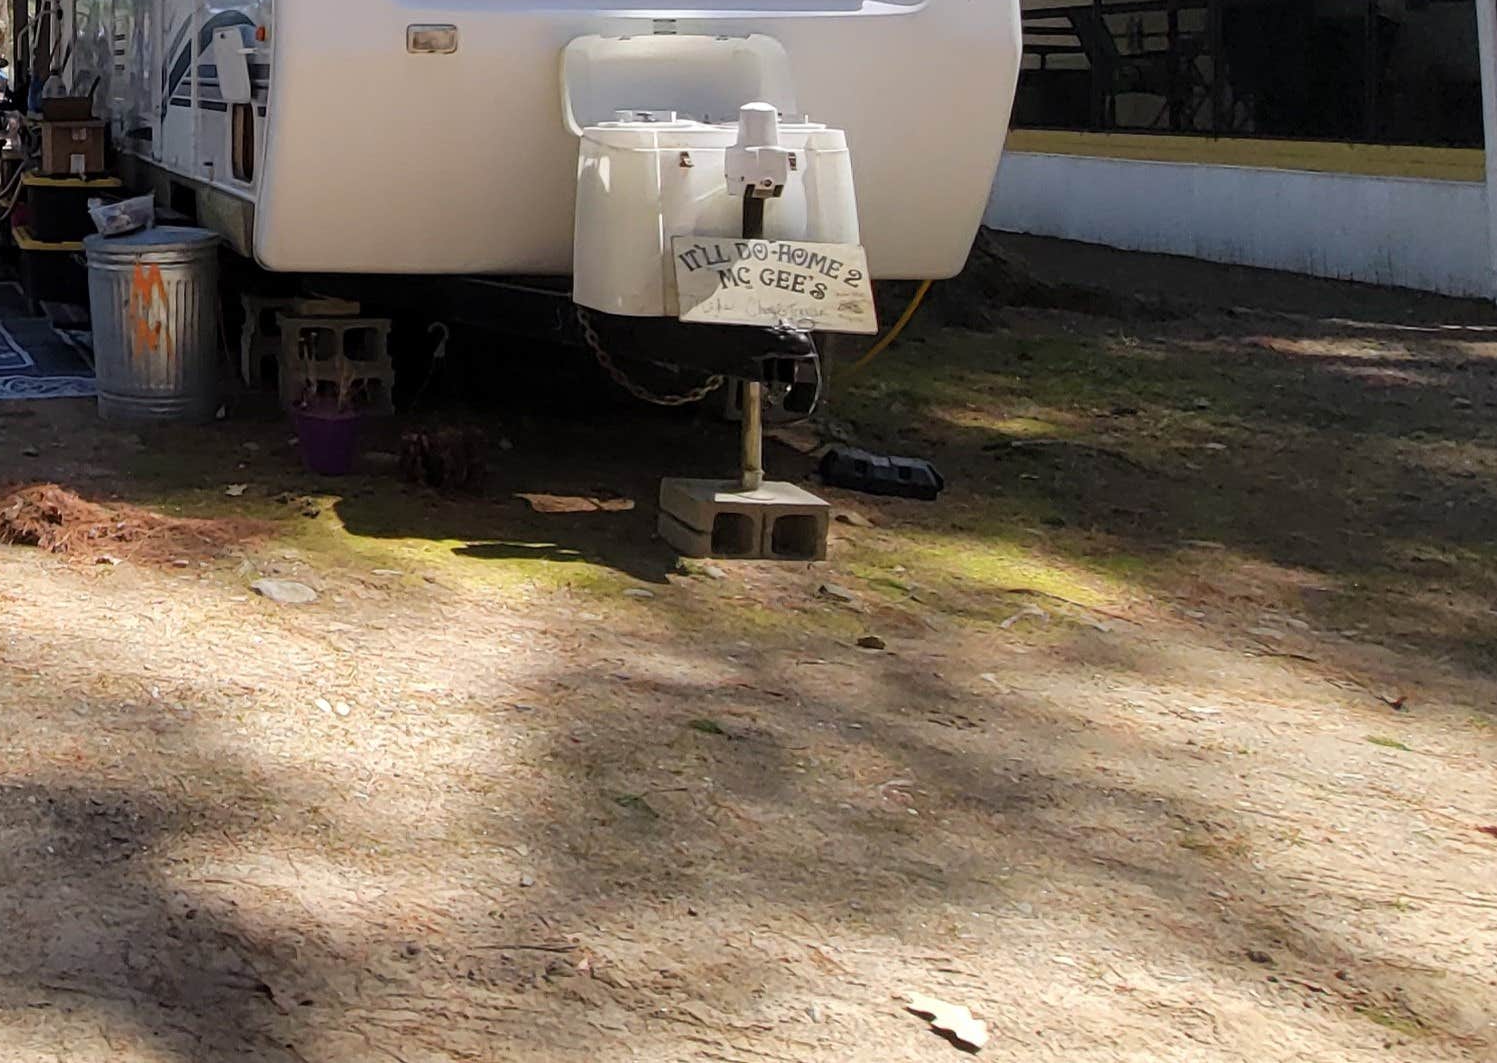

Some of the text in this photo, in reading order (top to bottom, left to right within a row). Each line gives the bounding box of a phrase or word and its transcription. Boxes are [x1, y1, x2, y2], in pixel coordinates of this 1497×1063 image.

[678, 243, 731, 273] IT'LL
[843, 268, 863, 288] 2
[759, 267, 828, 300] GEE'S
